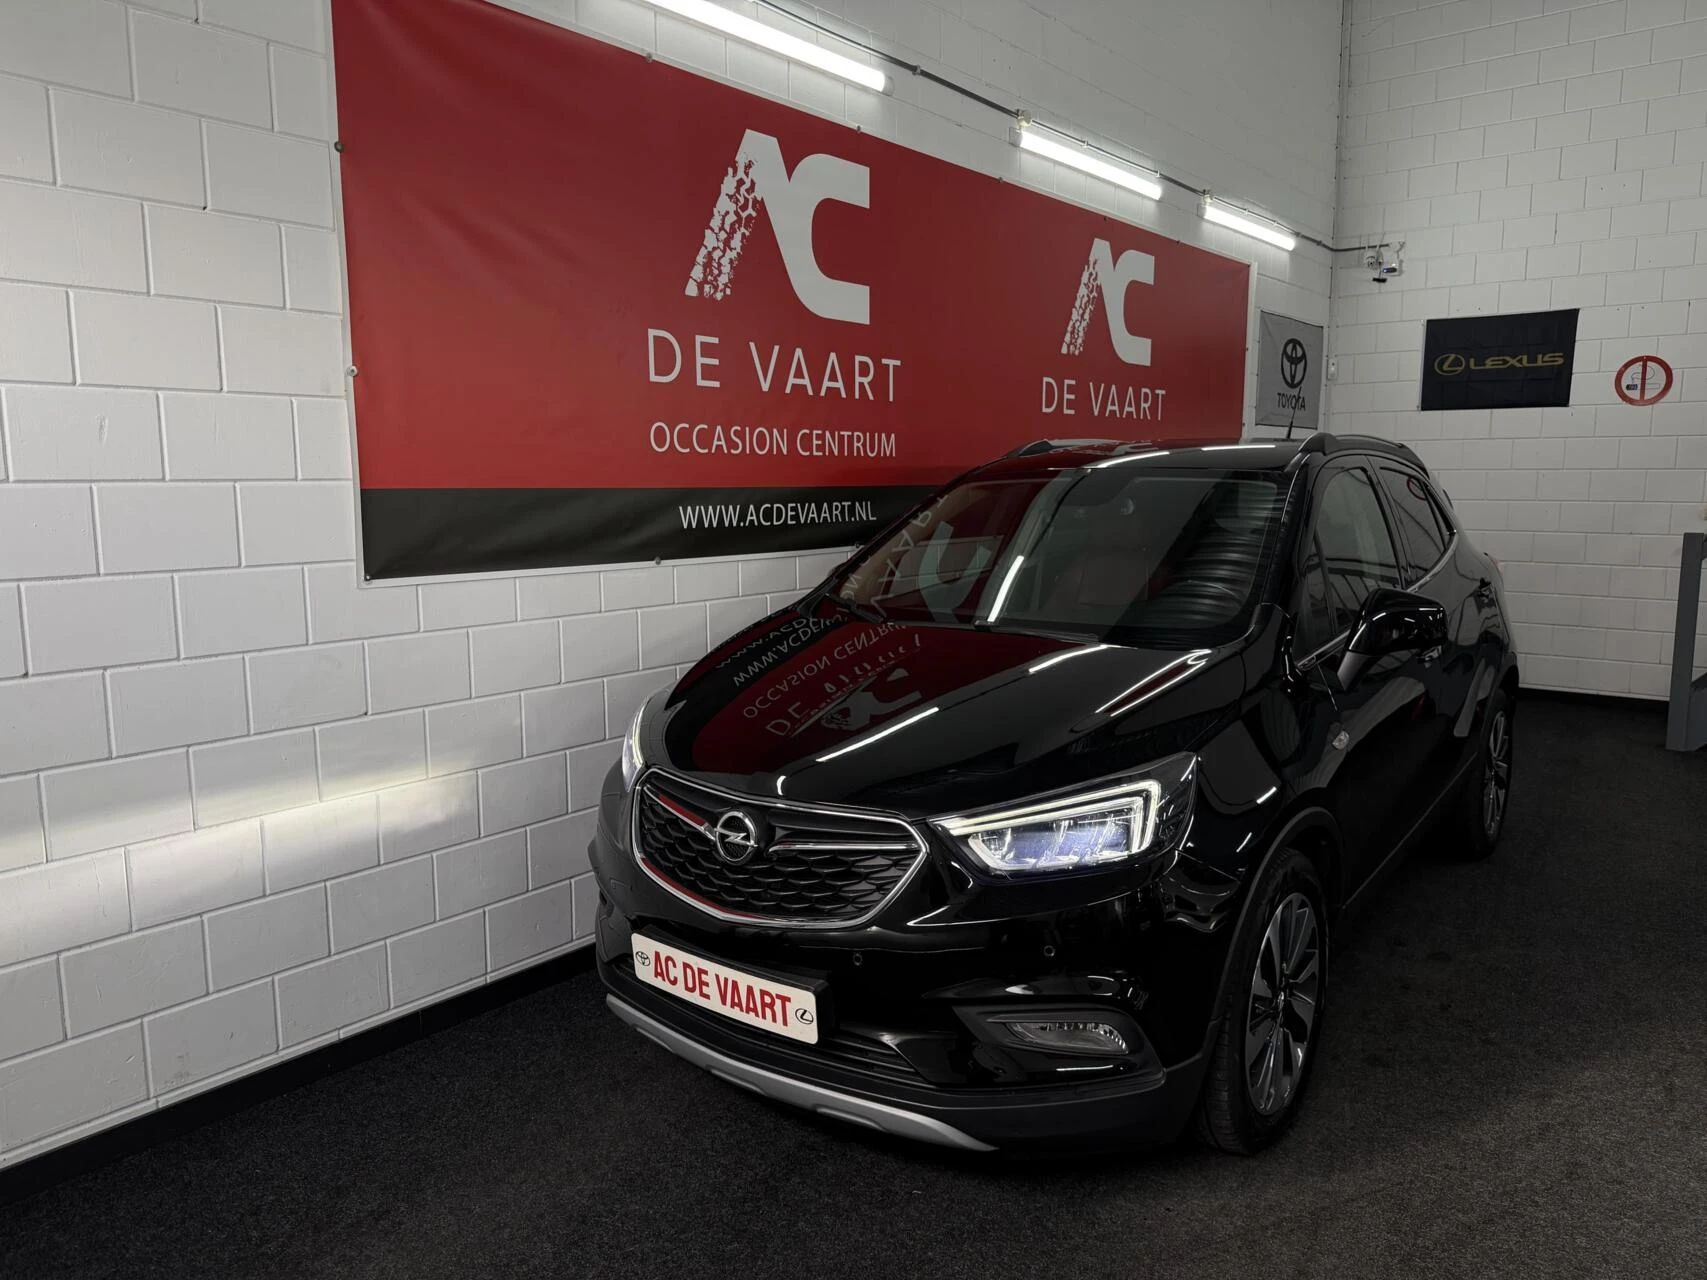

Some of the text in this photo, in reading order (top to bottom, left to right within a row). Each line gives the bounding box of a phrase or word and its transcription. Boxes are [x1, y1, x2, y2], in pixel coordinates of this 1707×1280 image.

[685, 129, 870, 325] AC
[1060, 238, 1156, 366] AC
[648, 328, 901, 402] DE VAART
[1469, 352, 1566, 371] LEXUS
[1041, 376, 1166, 421] DE VAART
[1277, 392, 1306, 412] TOYOTA
[649, 421, 896, 457] OCCASION CENTRUM
[679, 501, 877, 530] WWW.ACDEVAART.NL
[653, 950, 792, 1027] AC DE VAART
